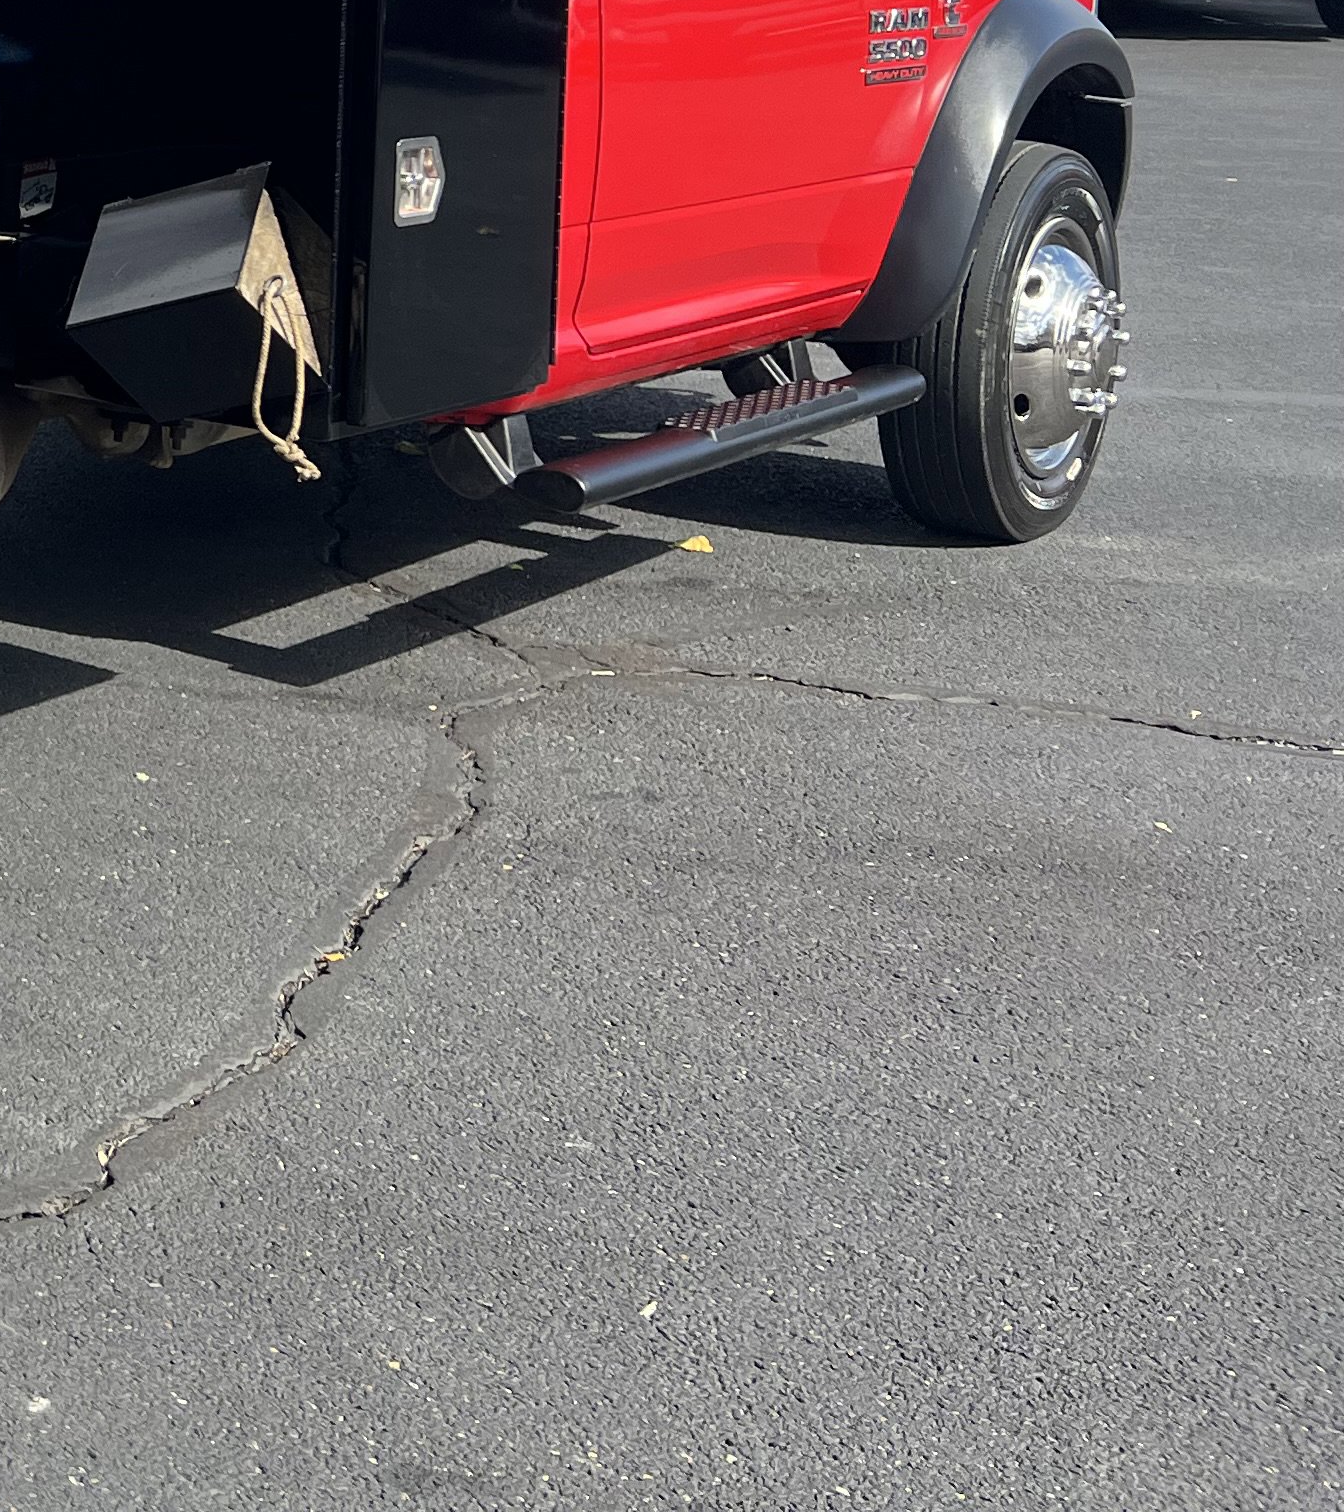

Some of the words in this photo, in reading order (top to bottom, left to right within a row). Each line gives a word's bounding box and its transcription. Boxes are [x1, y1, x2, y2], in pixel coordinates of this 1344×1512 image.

[869, 7, 930, 34] RAM
[868, 37, 928, 64] 5500
[870, 70, 900, 82] HEAVY
[901, 67, 924, 79] DUTY
